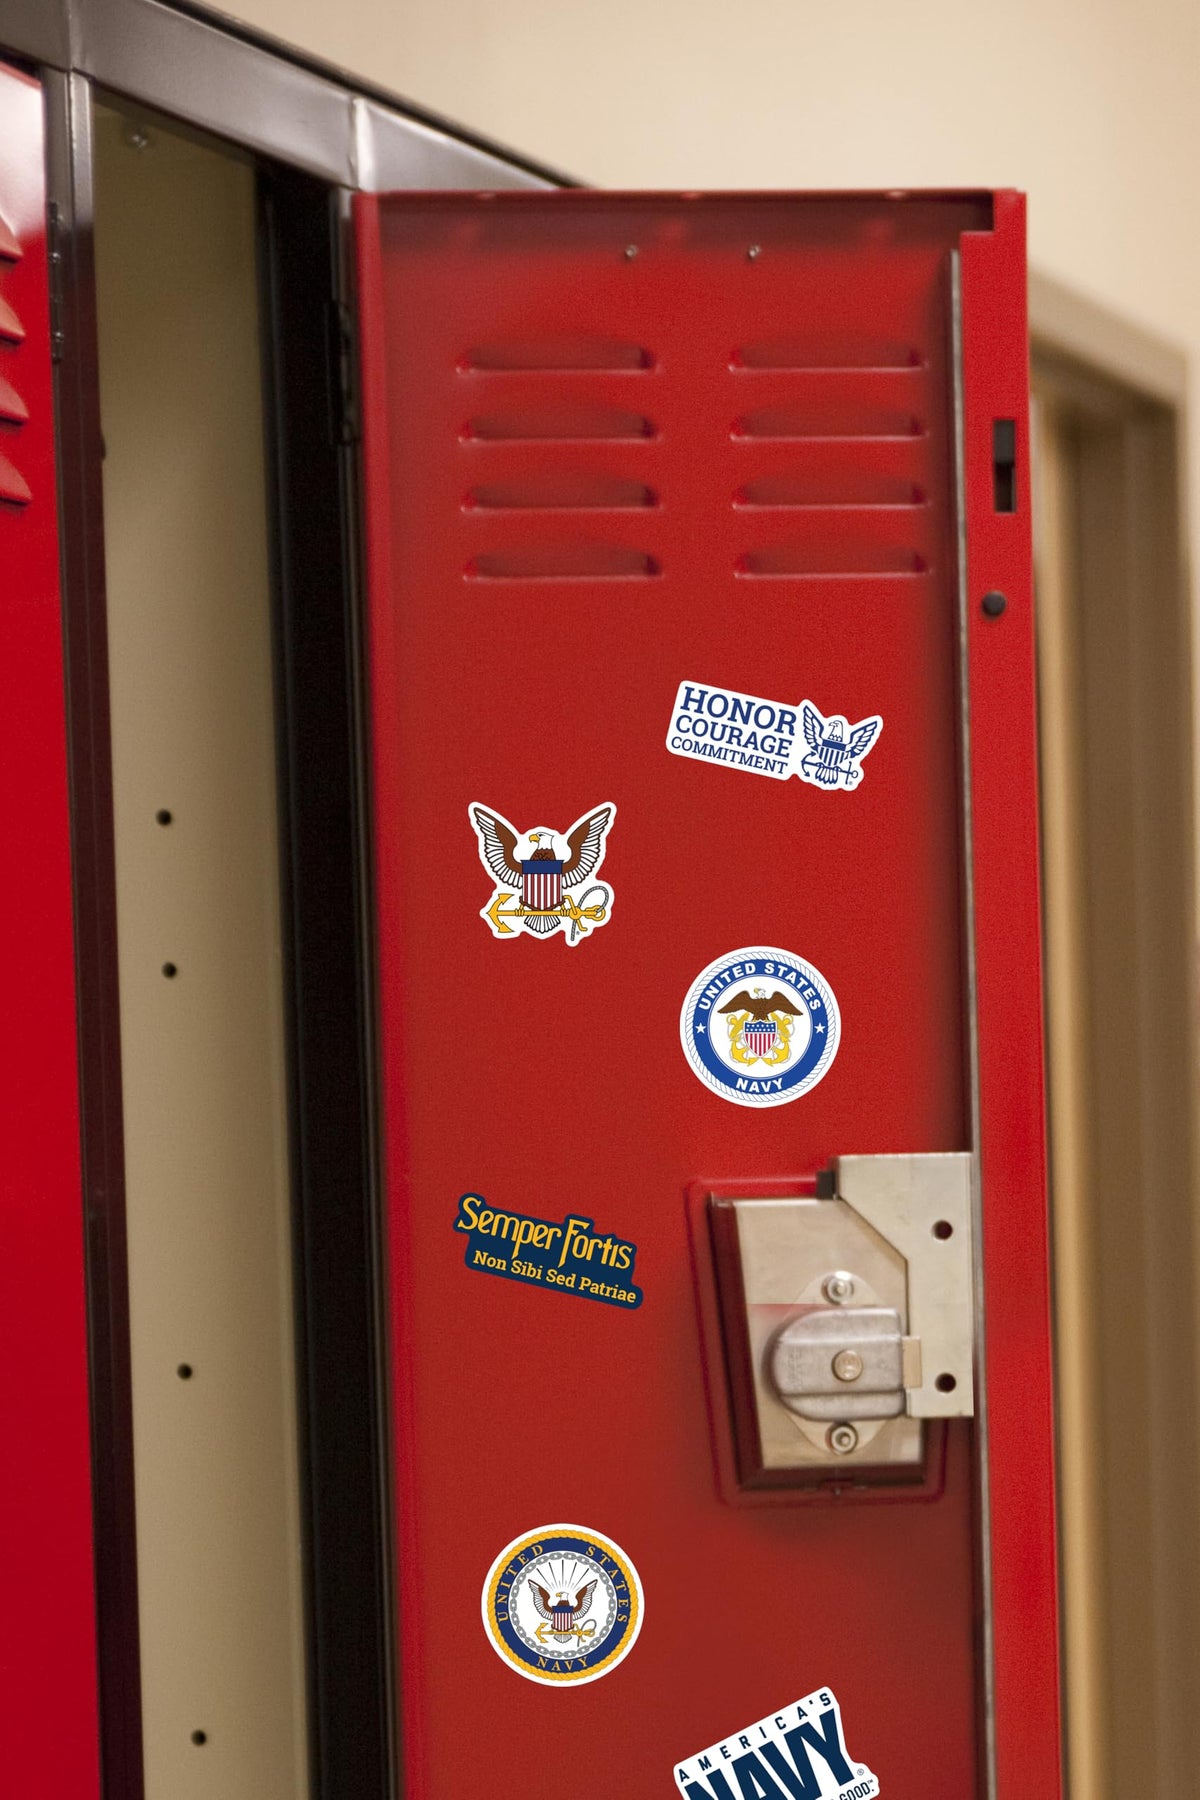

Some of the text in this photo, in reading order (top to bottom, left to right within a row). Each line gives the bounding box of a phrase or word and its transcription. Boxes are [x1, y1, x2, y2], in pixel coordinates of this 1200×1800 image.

[680, 686, 797, 736] HONOR
[671, 736, 788, 775] COMMITMENT
[675, 714, 793, 758] COURAGE
[698, 962, 821, 1011] UNITED STATES
[735, 1077, 783, 1093] NAVY
[457, 1196, 633, 1270] Semper Fortis
[473, 1250, 637, 1303] Non Sibi Sed Patriae
[497, 1544, 629, 1623] UNITED STATES
[537, 1655, 589, 1671] NAVY
[678, 1692, 831, 1782] AMERICA'S
